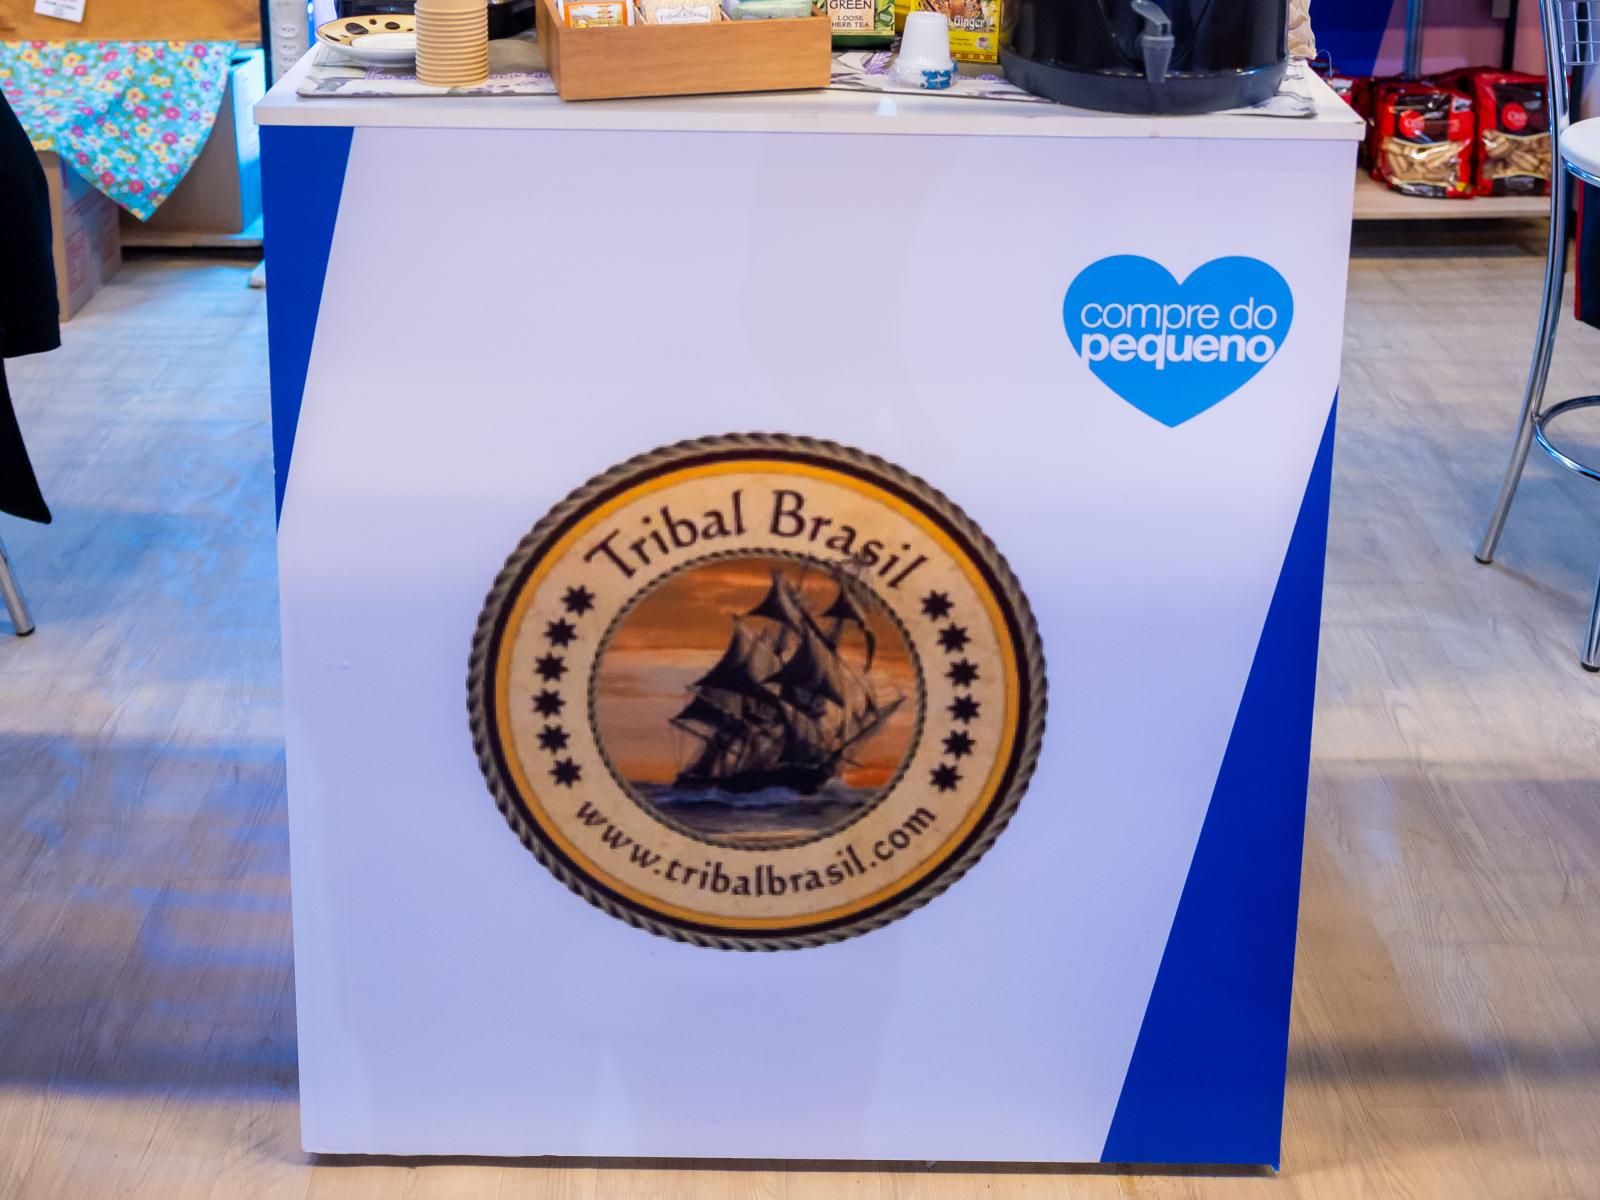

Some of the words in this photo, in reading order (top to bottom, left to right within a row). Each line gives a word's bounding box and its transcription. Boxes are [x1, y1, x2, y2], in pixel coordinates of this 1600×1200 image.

[829, 0, 872, 10] GREEN
[953, 15, 986, 30] Ginger
[1080, 302, 1220, 337] compre
[1229, 296, 1277, 330] do
[1081, 331, 1276, 371] pequeno
[583, 489, 747, 579] Tribal
[769, 489, 929, 589] Brasil
[574, 800, 938, 897] www.tribalbrasil.com
